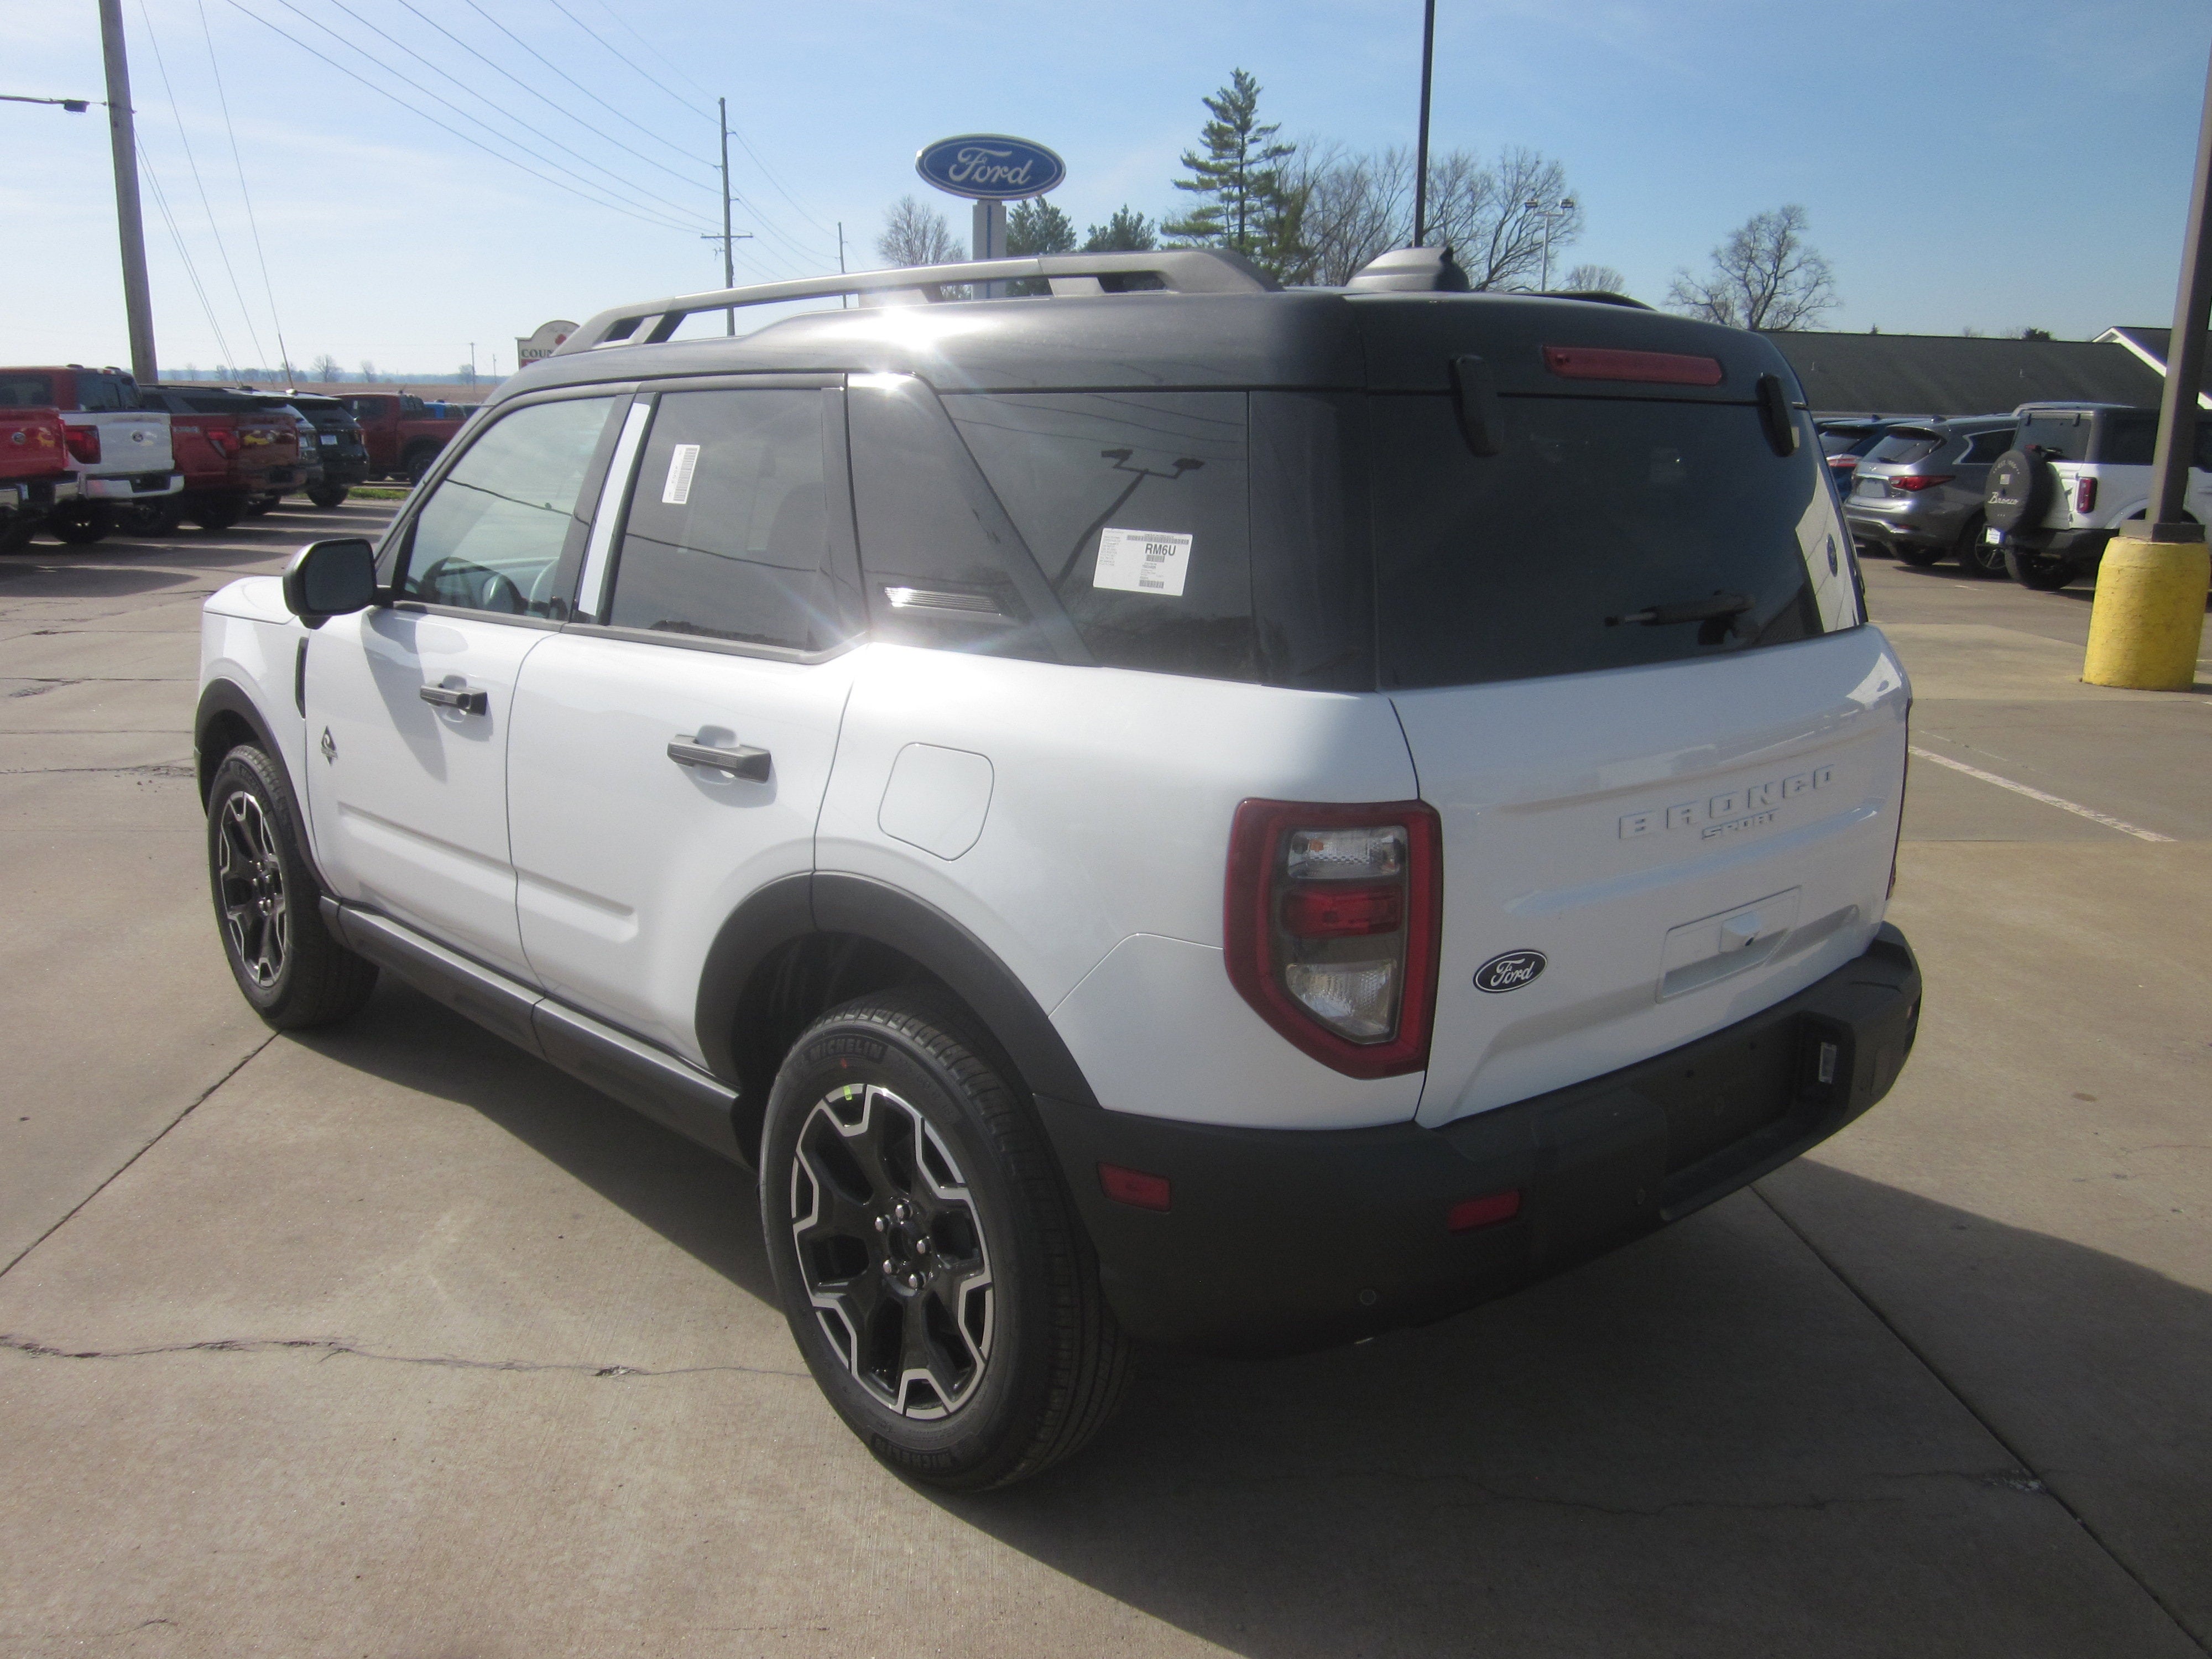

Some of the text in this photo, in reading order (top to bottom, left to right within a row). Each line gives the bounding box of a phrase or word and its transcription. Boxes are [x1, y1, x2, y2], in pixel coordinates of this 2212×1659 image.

[948, 147, 1033, 185] Ford
[1987, 491, 2018, 504] Bronco
[1145, 543, 1176, 556] RM6U
[1619, 764, 1835, 839] BRONCO
[1701, 807, 1780, 840] SPORT
[1490, 958, 1536, 987] Ford
[809, 1038, 883, 1061] MICHELIN
